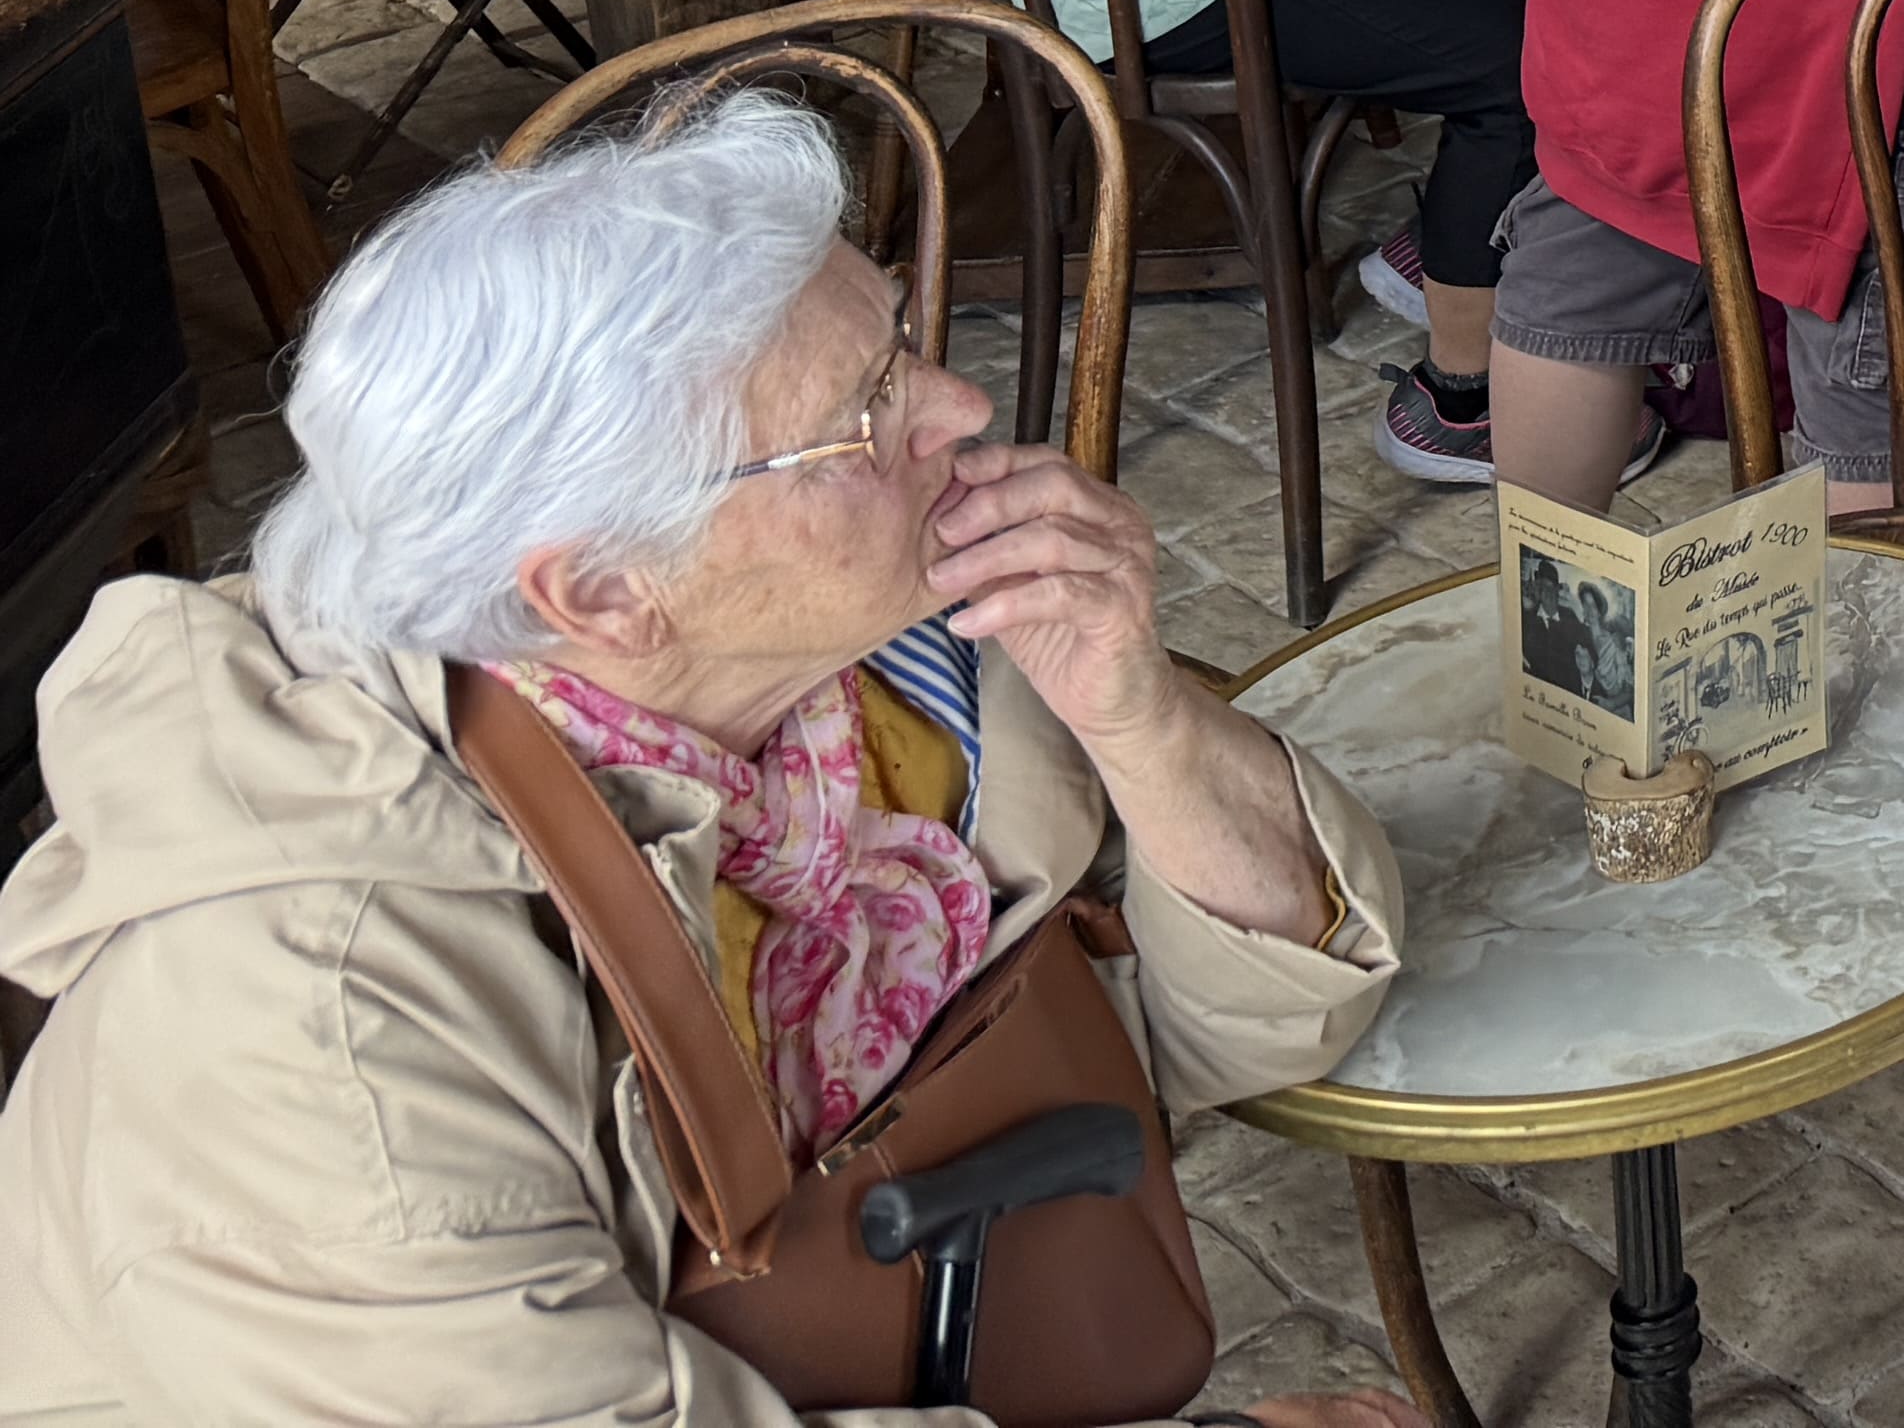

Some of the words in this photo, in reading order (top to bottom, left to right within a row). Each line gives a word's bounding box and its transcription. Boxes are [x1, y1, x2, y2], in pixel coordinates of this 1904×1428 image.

[1658, 530, 1754, 587] Bistrot
[1760, 521, 1809, 547] 1900
[1685, 593, 1705, 613] du
